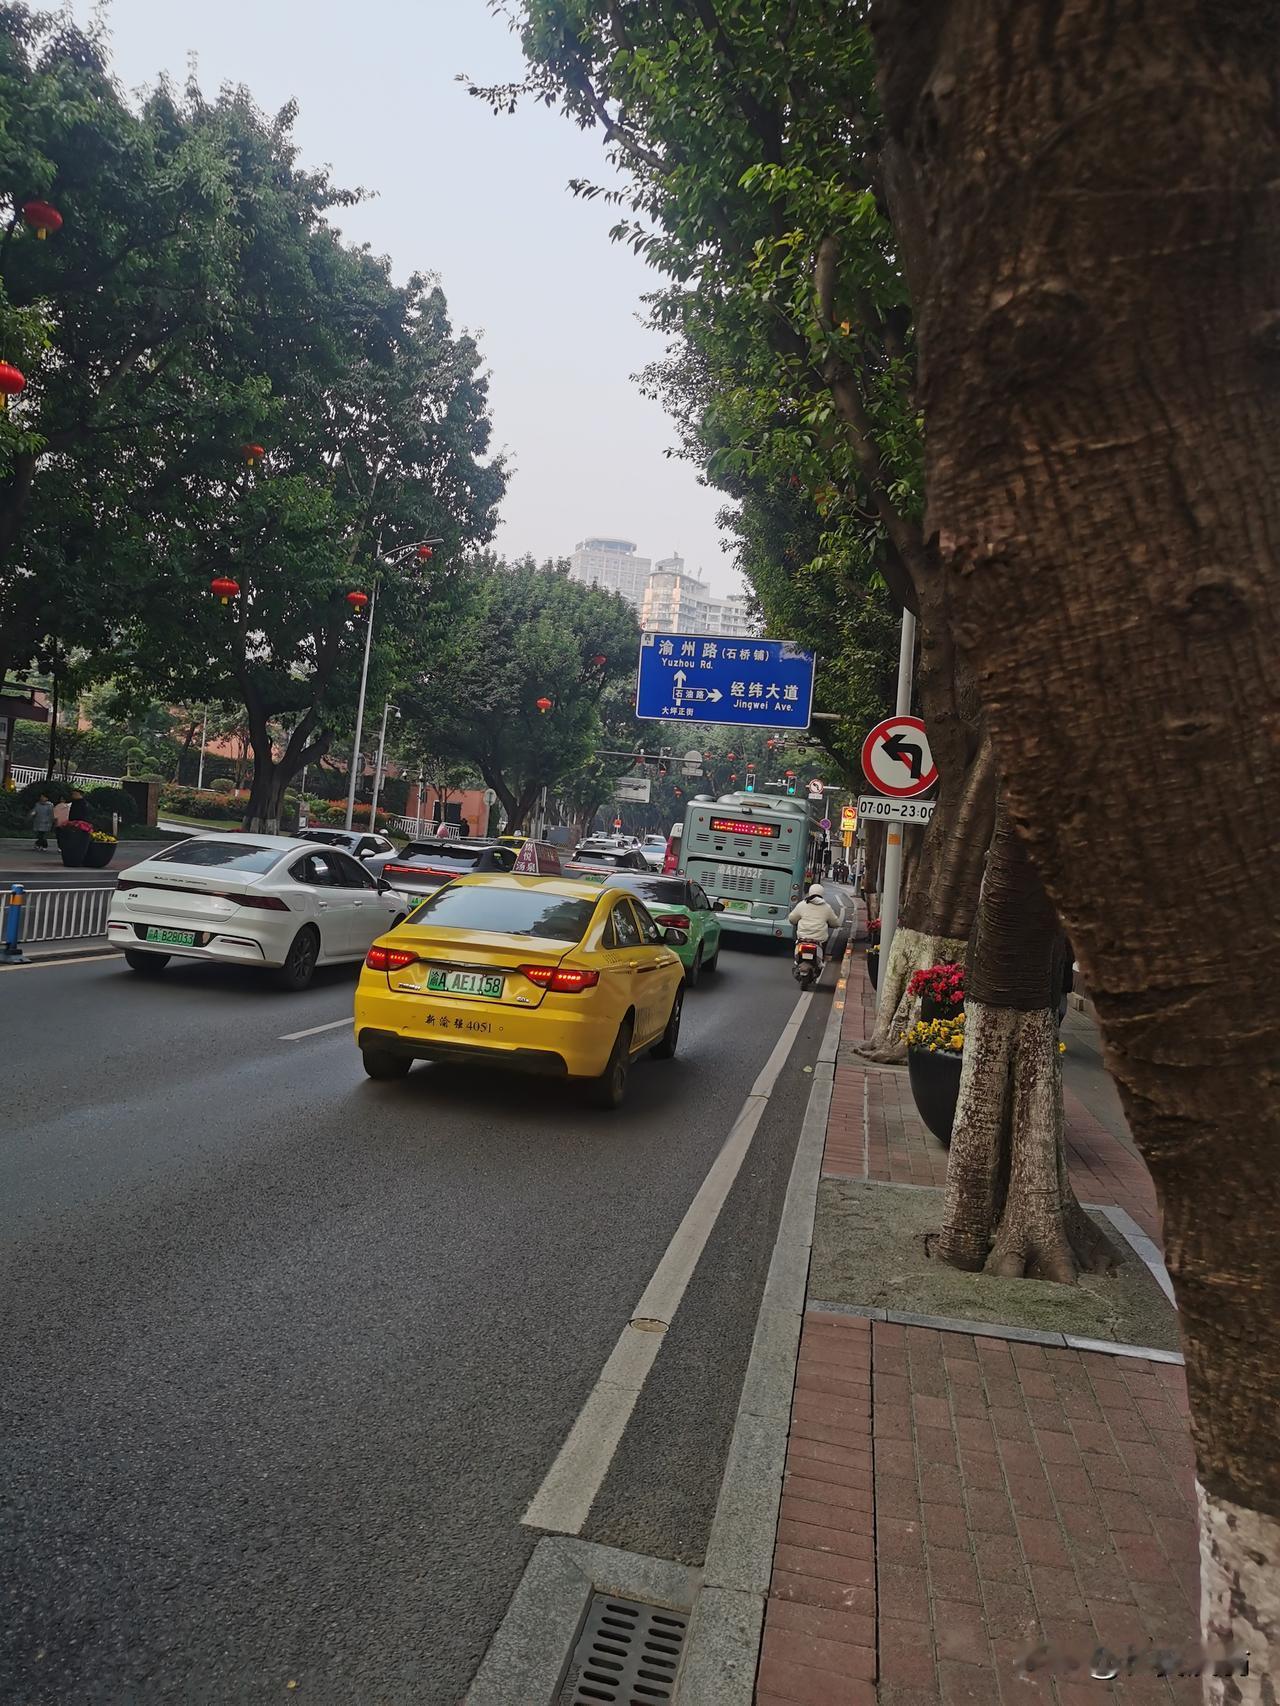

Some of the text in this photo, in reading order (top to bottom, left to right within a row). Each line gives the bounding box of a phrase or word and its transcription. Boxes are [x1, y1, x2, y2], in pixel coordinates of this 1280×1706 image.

[662, 657, 713, 669] Yuzhou Rd.
[675, 689, 705, 700] 石油路
[730, 681, 799, 701] 经纬大道
[661, 706, 694, 717] 大坪正街
[733, 701, 794, 712] Jingwei Ave.
